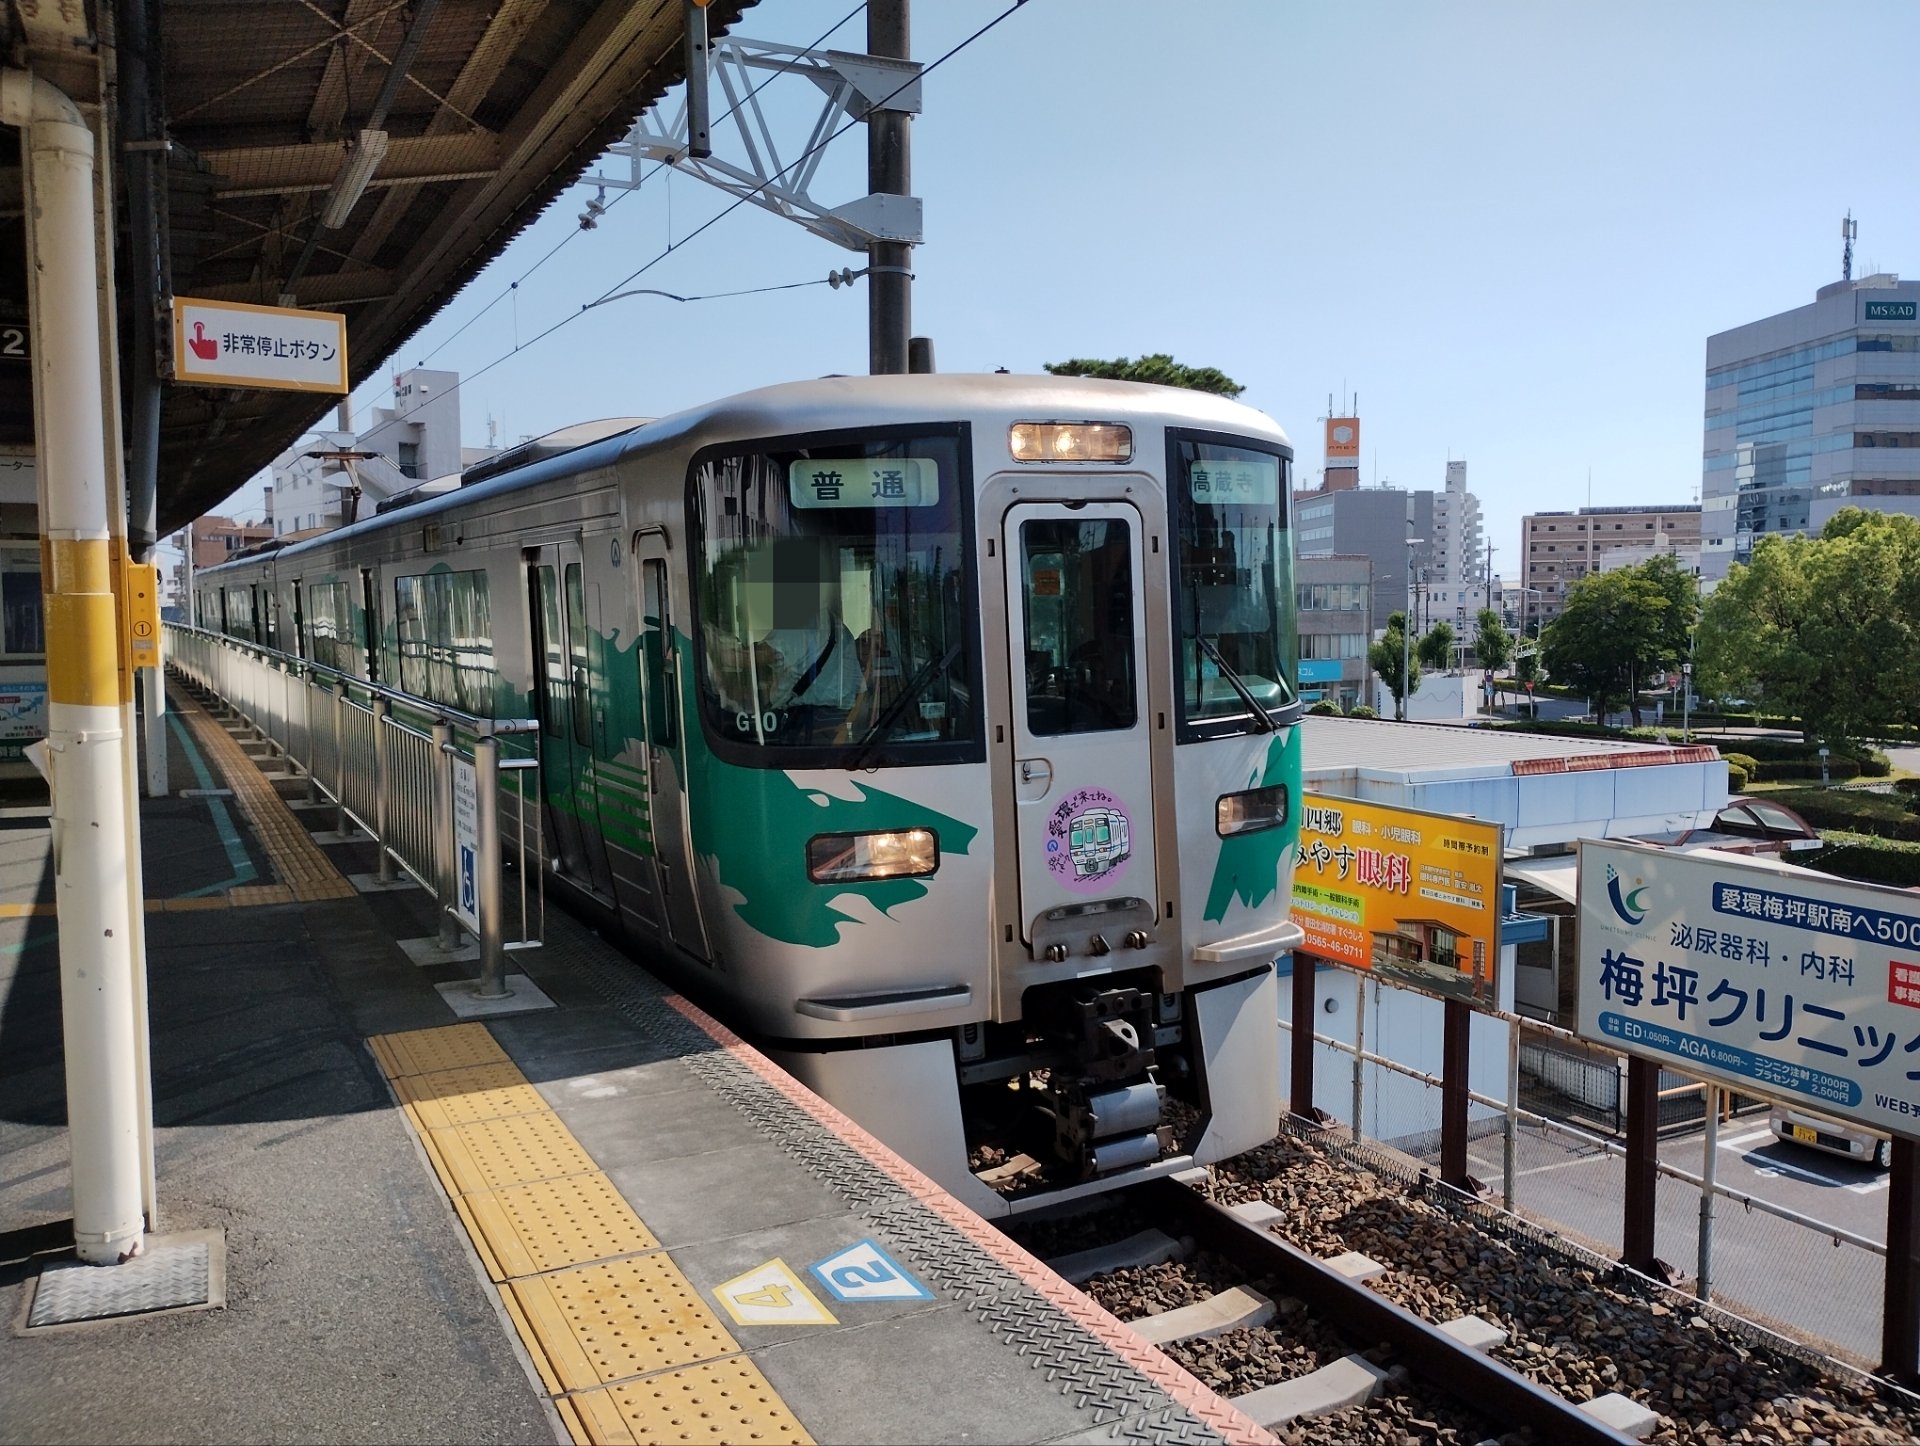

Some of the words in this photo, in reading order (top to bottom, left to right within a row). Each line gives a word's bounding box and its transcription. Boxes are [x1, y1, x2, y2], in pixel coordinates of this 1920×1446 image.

[1871, 305, 1914, 316] MS&AD
[3, 329, 25, 355] 2
[223, 332, 336, 361] 非常停止ボタン
[811, 470, 906, 501] 普通
[1193, 470, 1254, 494] 高蔵寺
[1301, 805, 1342, 836] 四郷
[1306, 933, 1364, 959] 0565-46-9711
[1670, 921, 1855, 987] 泌尿器科・内科
[1679, 1037, 1710, 1059] AGA
[1755, 1057, 1810, 1081] ニンニク注射
[831, 1260, 898, 1289] 2
[733, 1283, 792, 1309] 4
